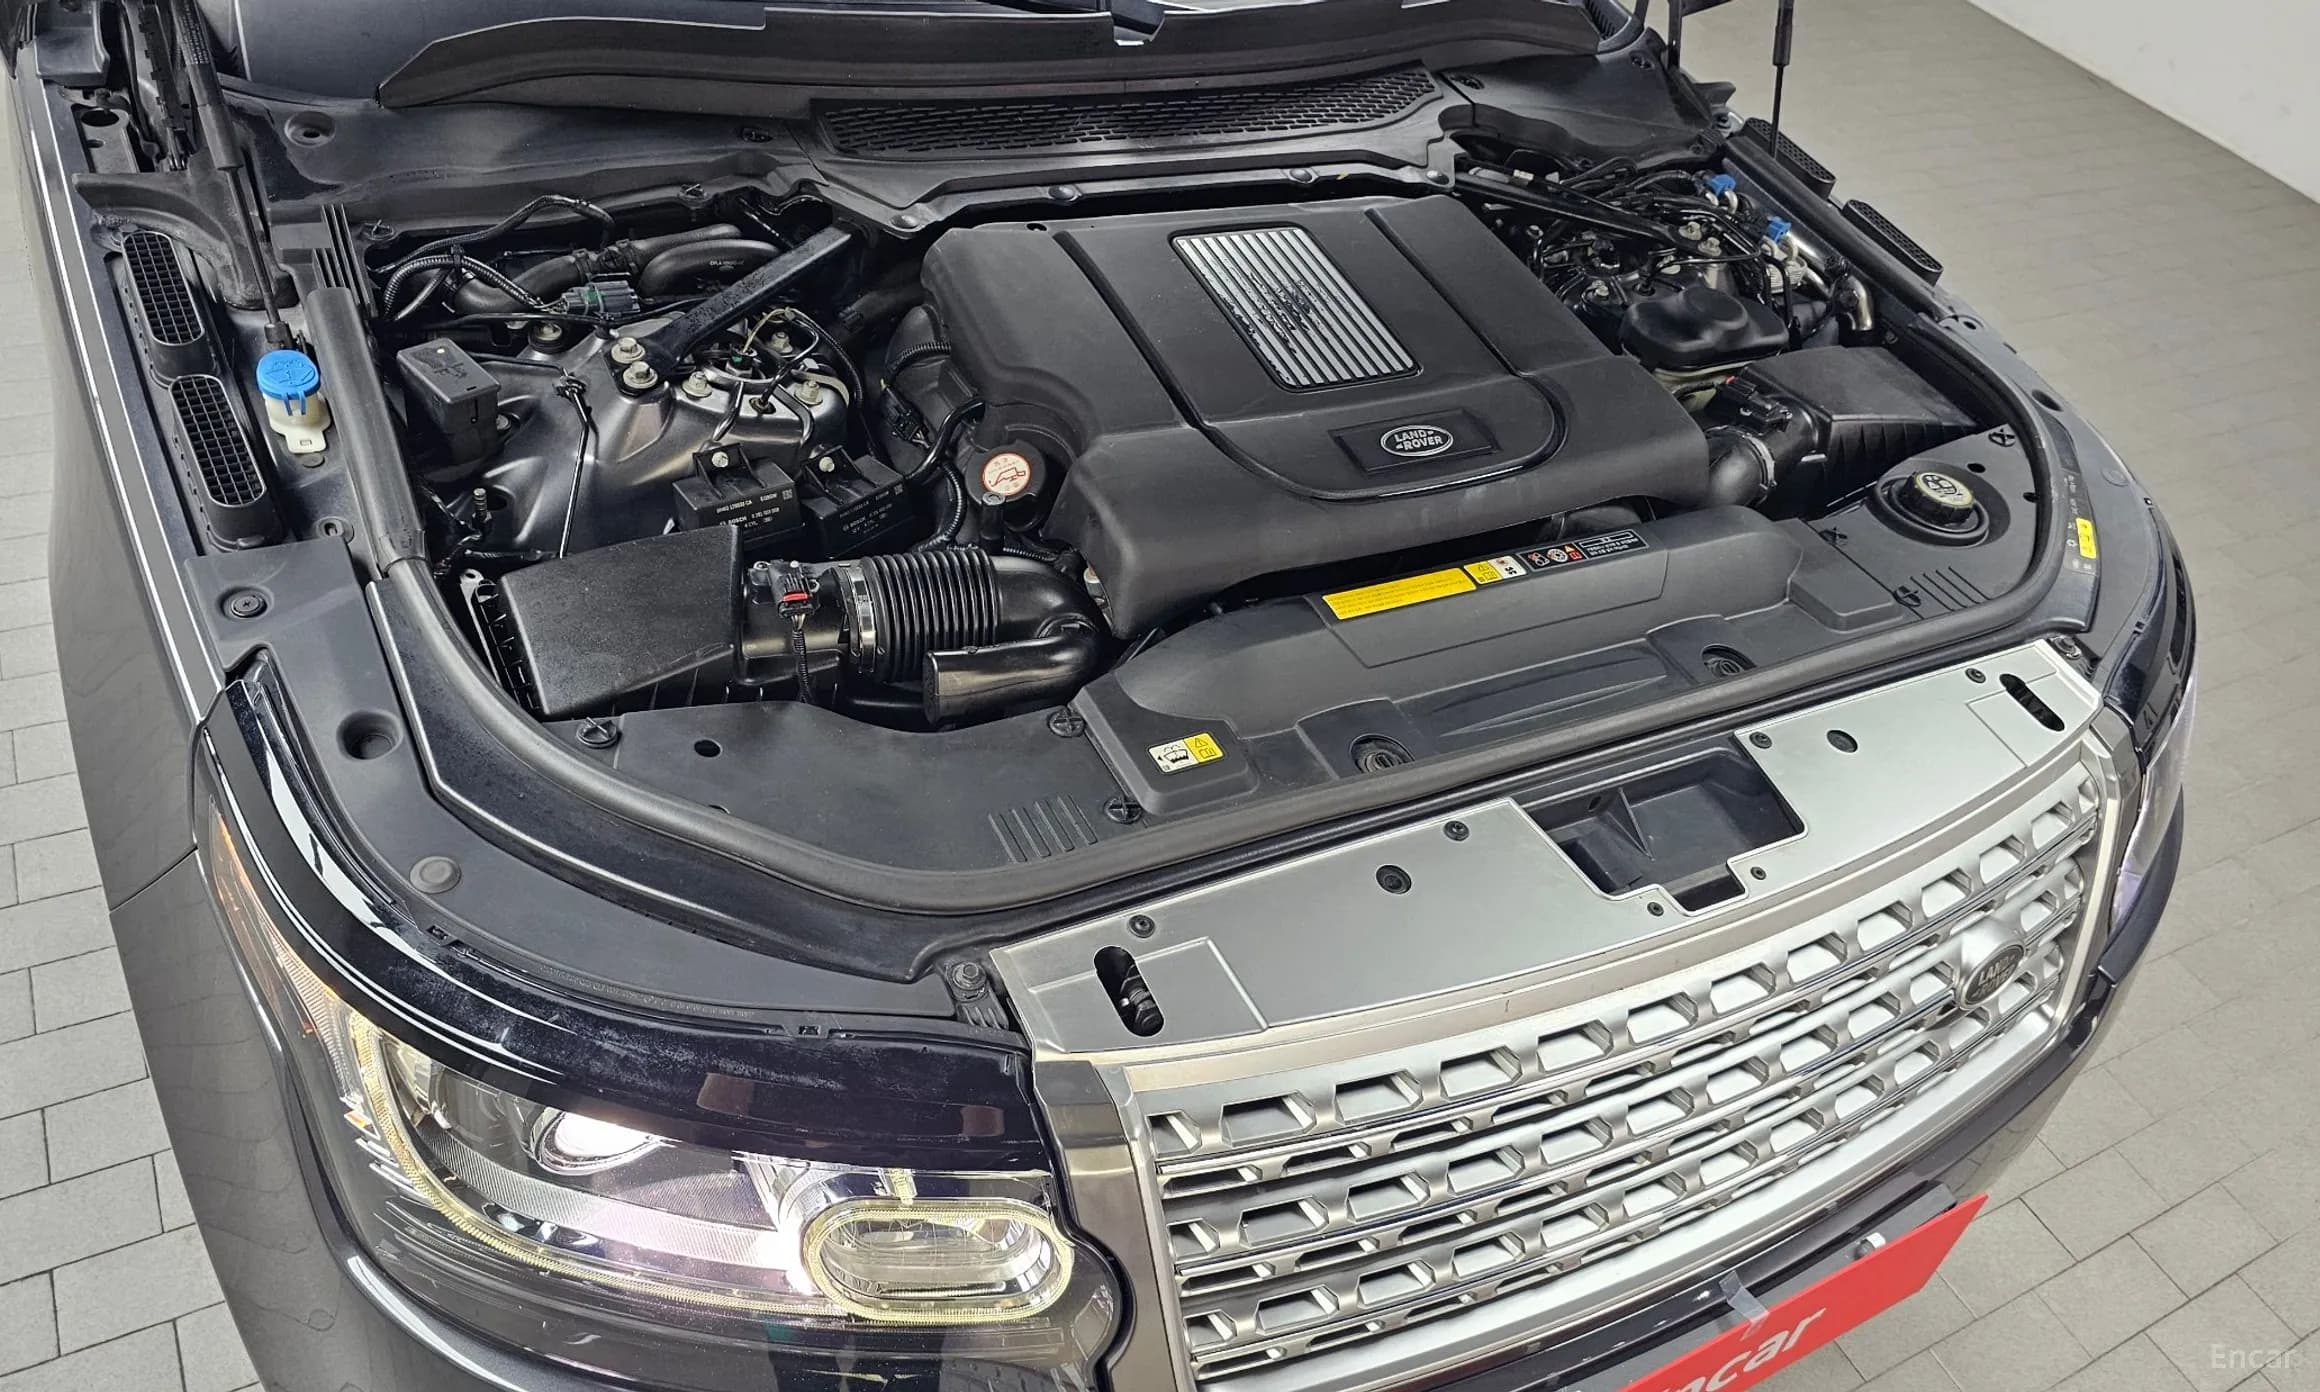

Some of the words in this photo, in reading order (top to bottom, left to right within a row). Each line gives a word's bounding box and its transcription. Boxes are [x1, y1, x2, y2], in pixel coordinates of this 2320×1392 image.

[1394, 429, 1427, 442] LAND
[1403, 435, 1443, 450] ROVER
[1978, 957, 2010, 986] LAND
